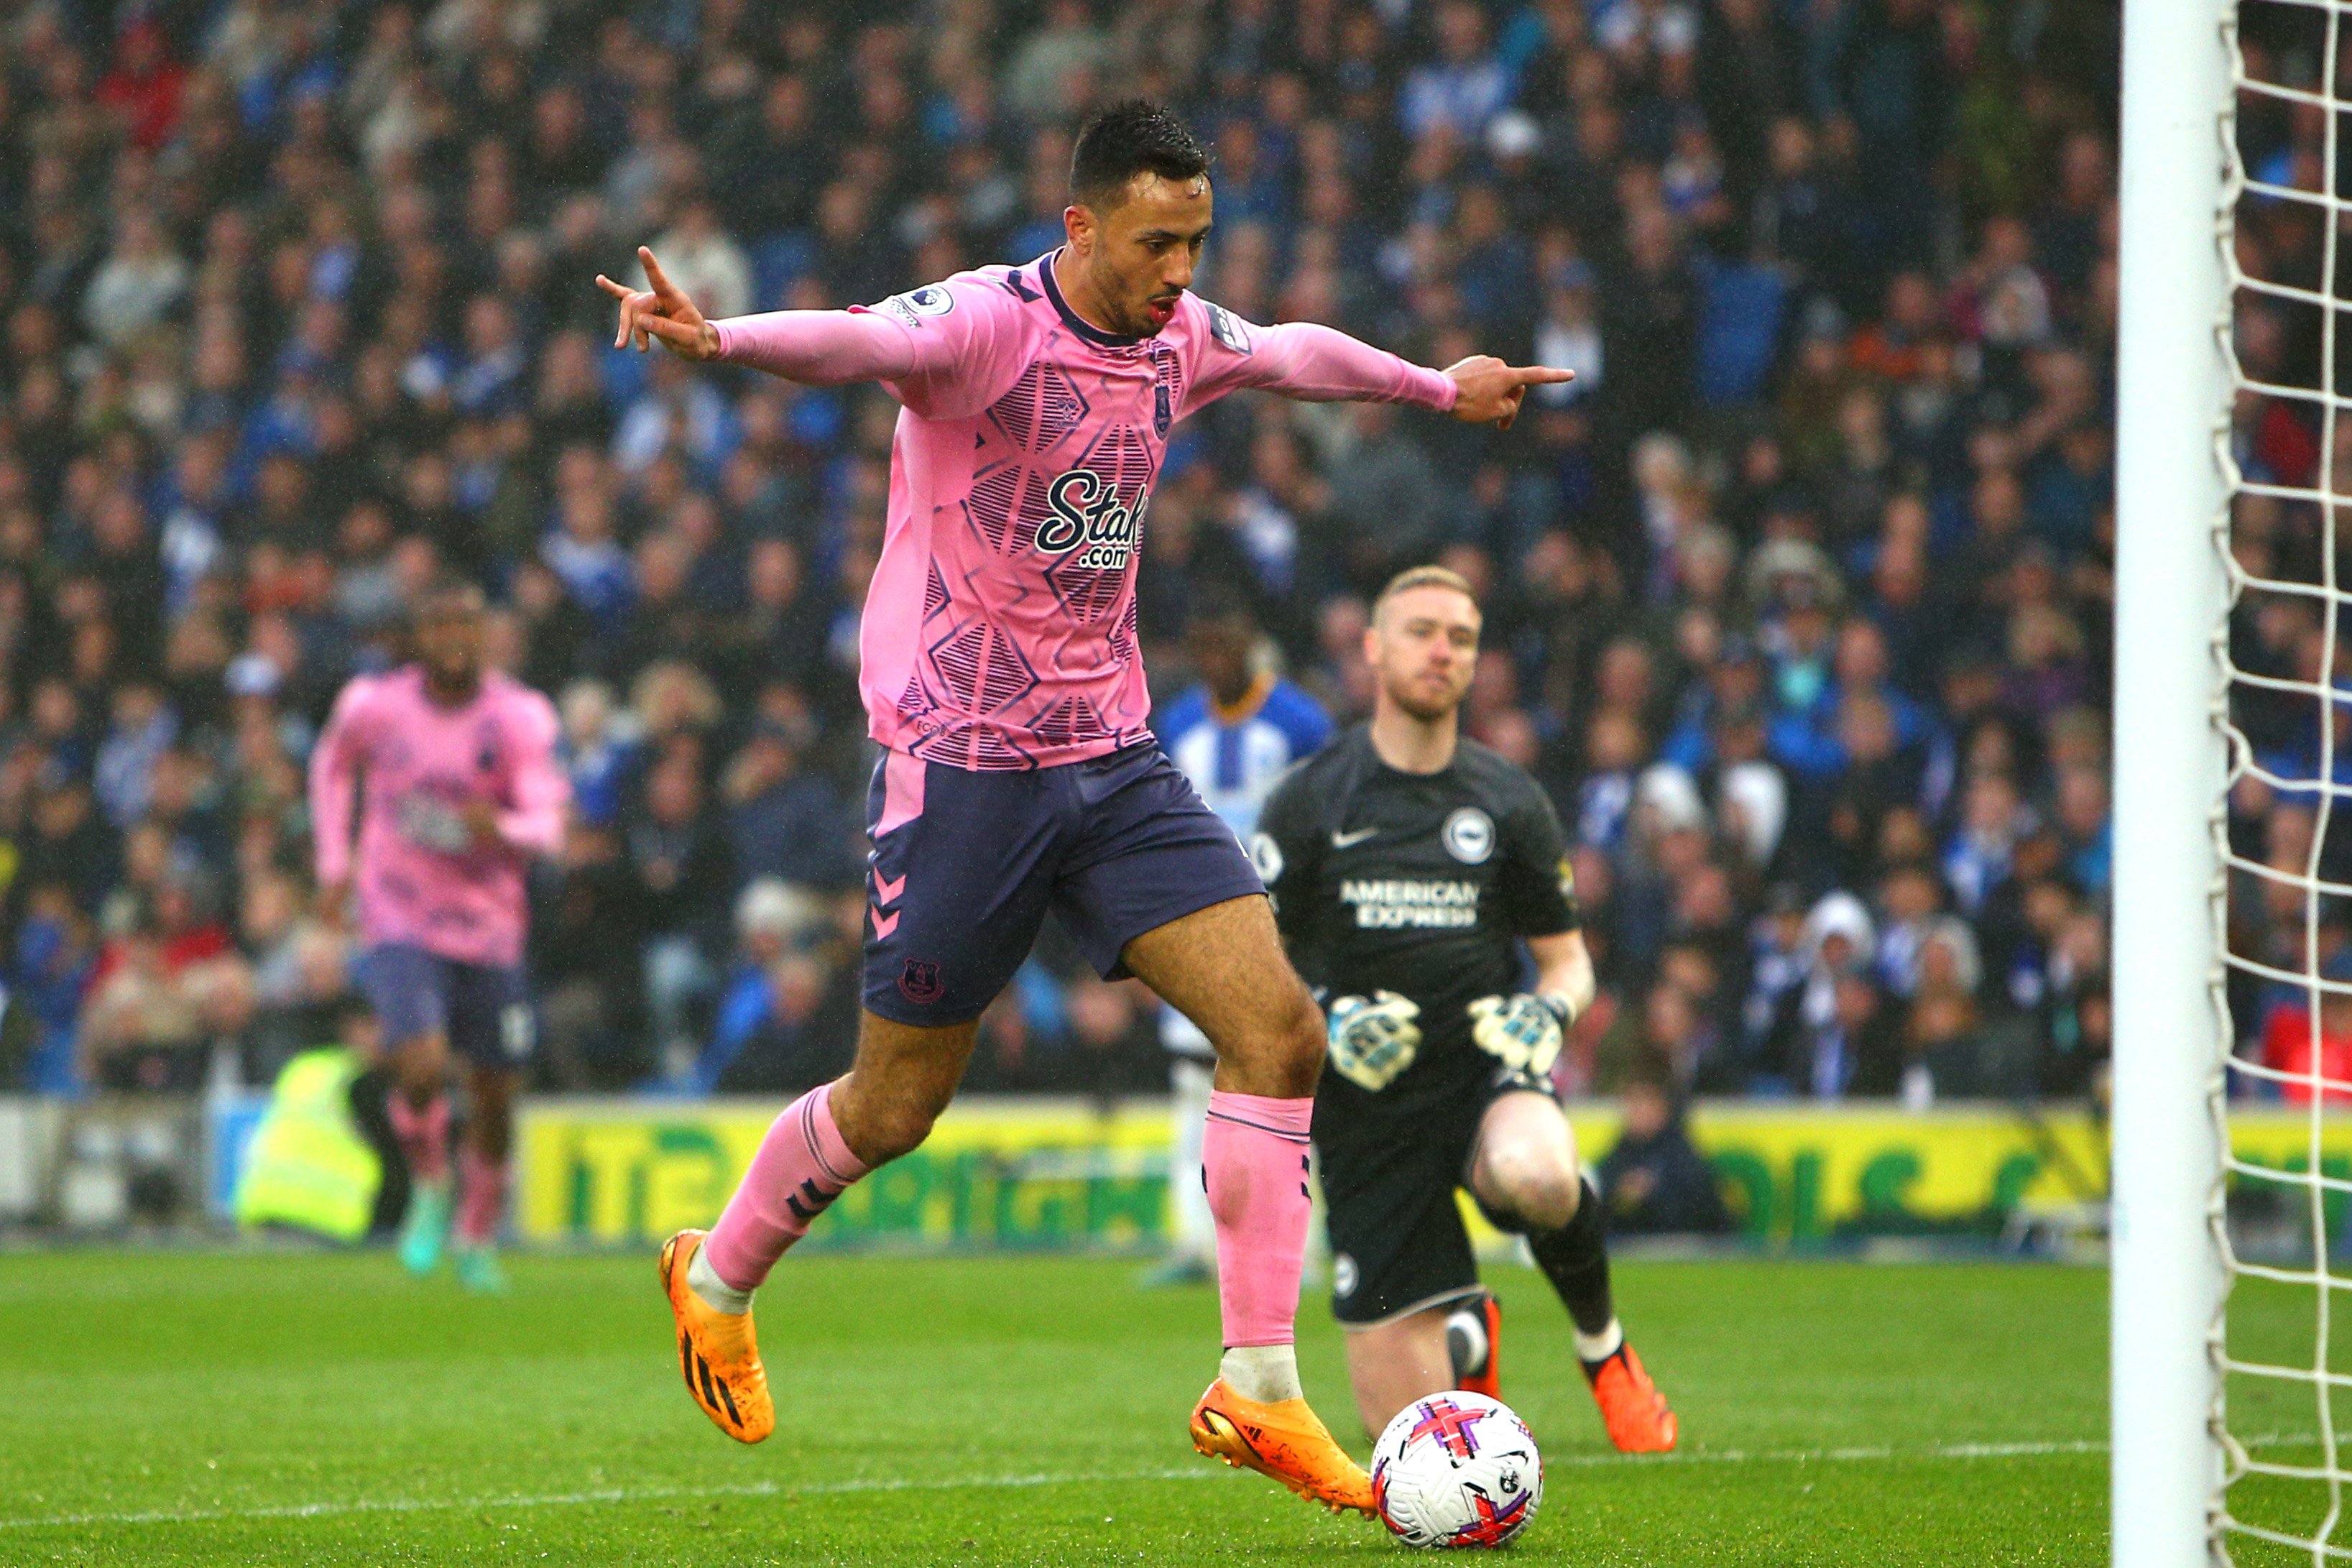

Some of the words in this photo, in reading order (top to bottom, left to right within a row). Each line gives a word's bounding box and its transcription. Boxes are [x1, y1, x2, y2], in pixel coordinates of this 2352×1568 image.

[1214, 304, 1236, 346] BOX
[1035, 469, 1149, 553] Stak
[1339, 878, 1481, 903] AMERICAN
[1356, 904, 1477, 928] EXPRESS
